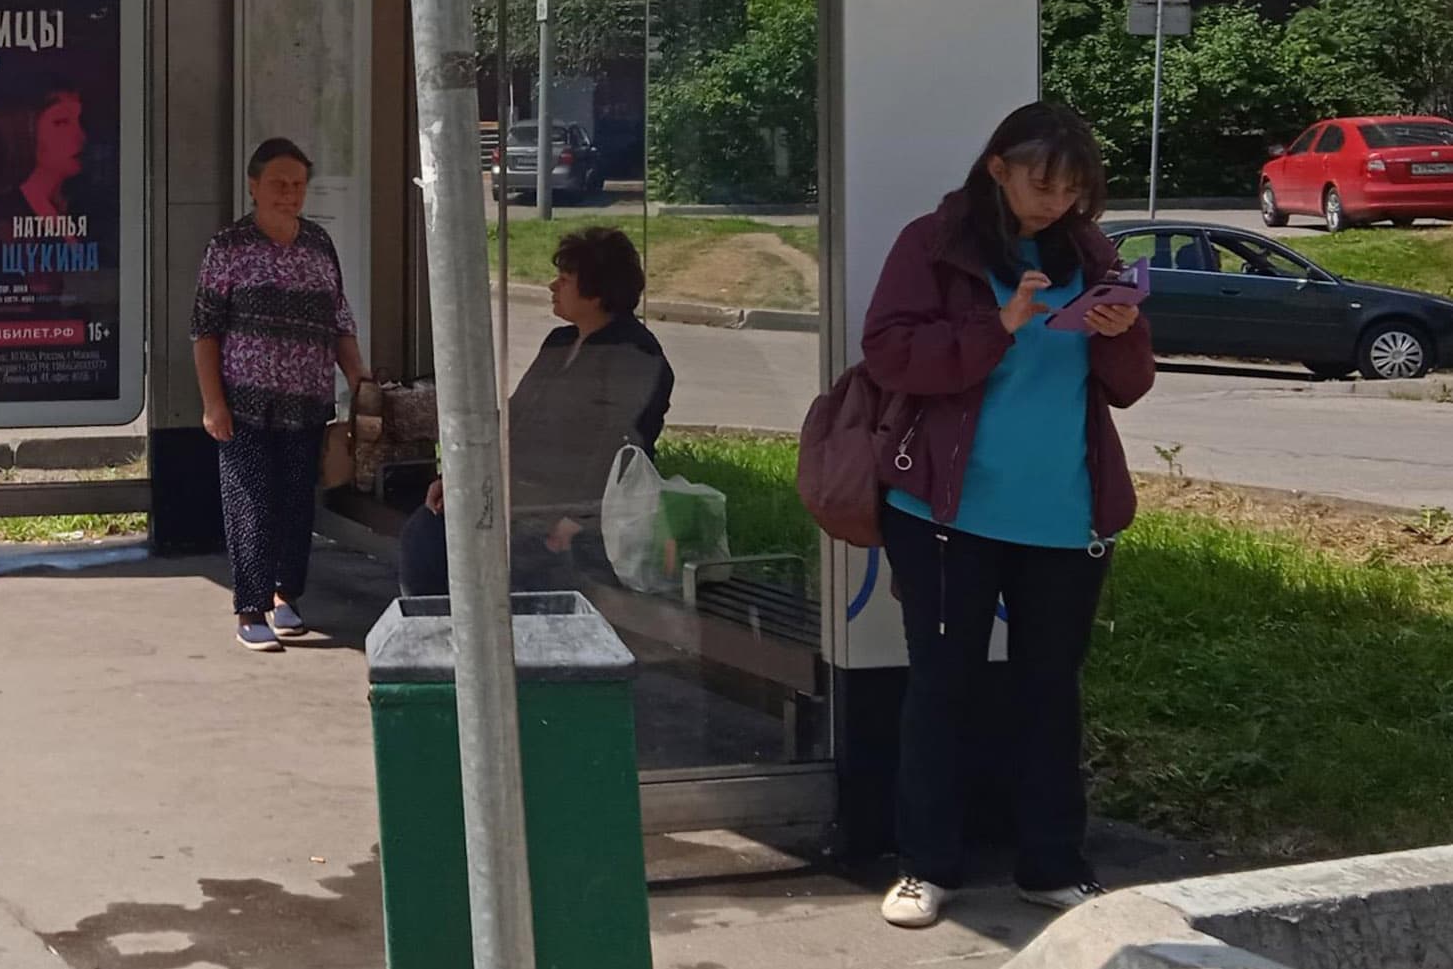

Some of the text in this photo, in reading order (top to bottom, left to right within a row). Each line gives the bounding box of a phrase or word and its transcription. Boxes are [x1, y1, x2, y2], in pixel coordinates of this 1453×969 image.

[13, 215, 88, 238] НАТАЛЬЯ
[2, 242, 99, 276] ЩУКИНА
[88, 321, 111, 342] 16+
